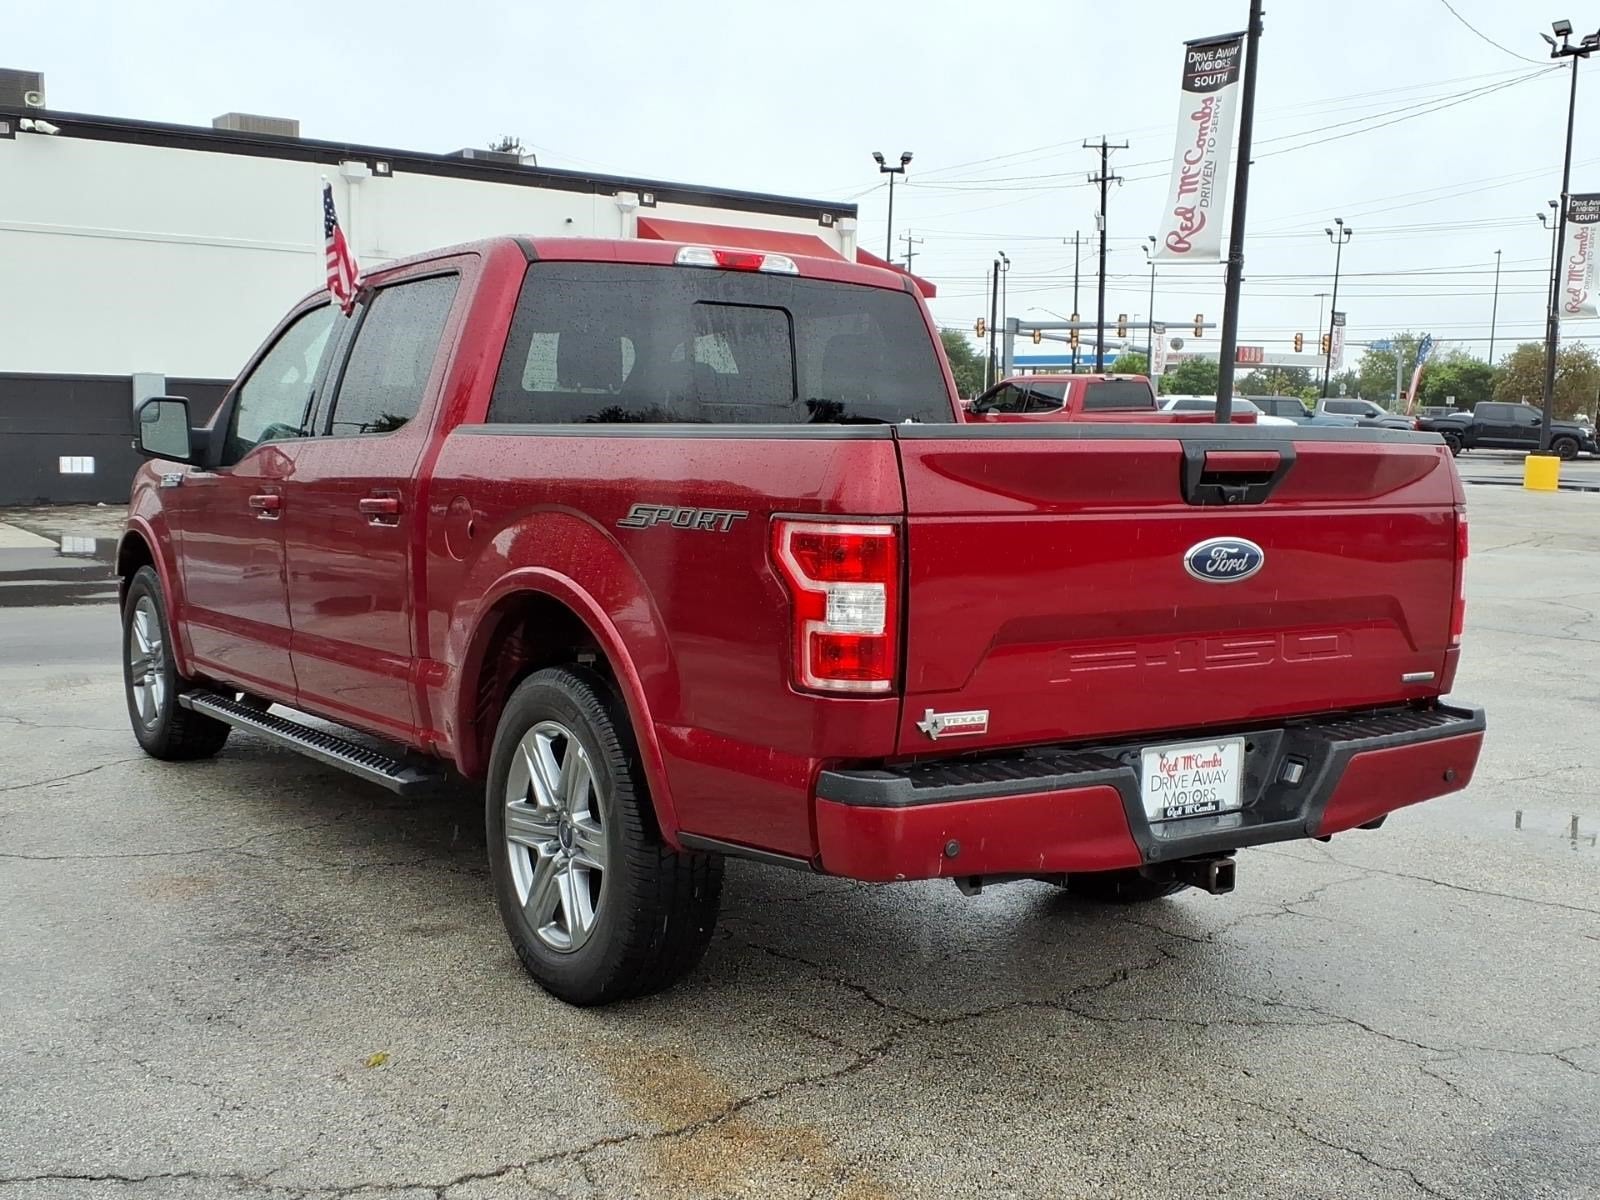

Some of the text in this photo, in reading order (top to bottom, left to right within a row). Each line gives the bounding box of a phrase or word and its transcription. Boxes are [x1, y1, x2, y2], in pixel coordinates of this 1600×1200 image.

[1188, 45, 1240, 63] DRIVE AWAY
[1194, 58, 1231, 72] MOTORS
[1194, 72, 1228, 87] SOUTH
[1200, 95, 1223, 208] DRIVEN TO SERVE
[1165, 96, 1215, 253] Red McCombs
[1575, 213, 1599, 221] SOUTH
[1565, 227, 1589, 313] Red McCombs
[616, 502, 749, 533] SPORT
[1206, 546, 1249, 573] Ford
[1050, 631, 1352, 682] F-150
[945, 713, 985, 725] TEXAS
[1160, 753, 1222, 777] Red McCombs
[1151, 769, 1229, 792] DRIVE AWAY
[1163, 788, 1216, 806] MOTORS
[1166, 802, 1216, 817] Red McCombs
